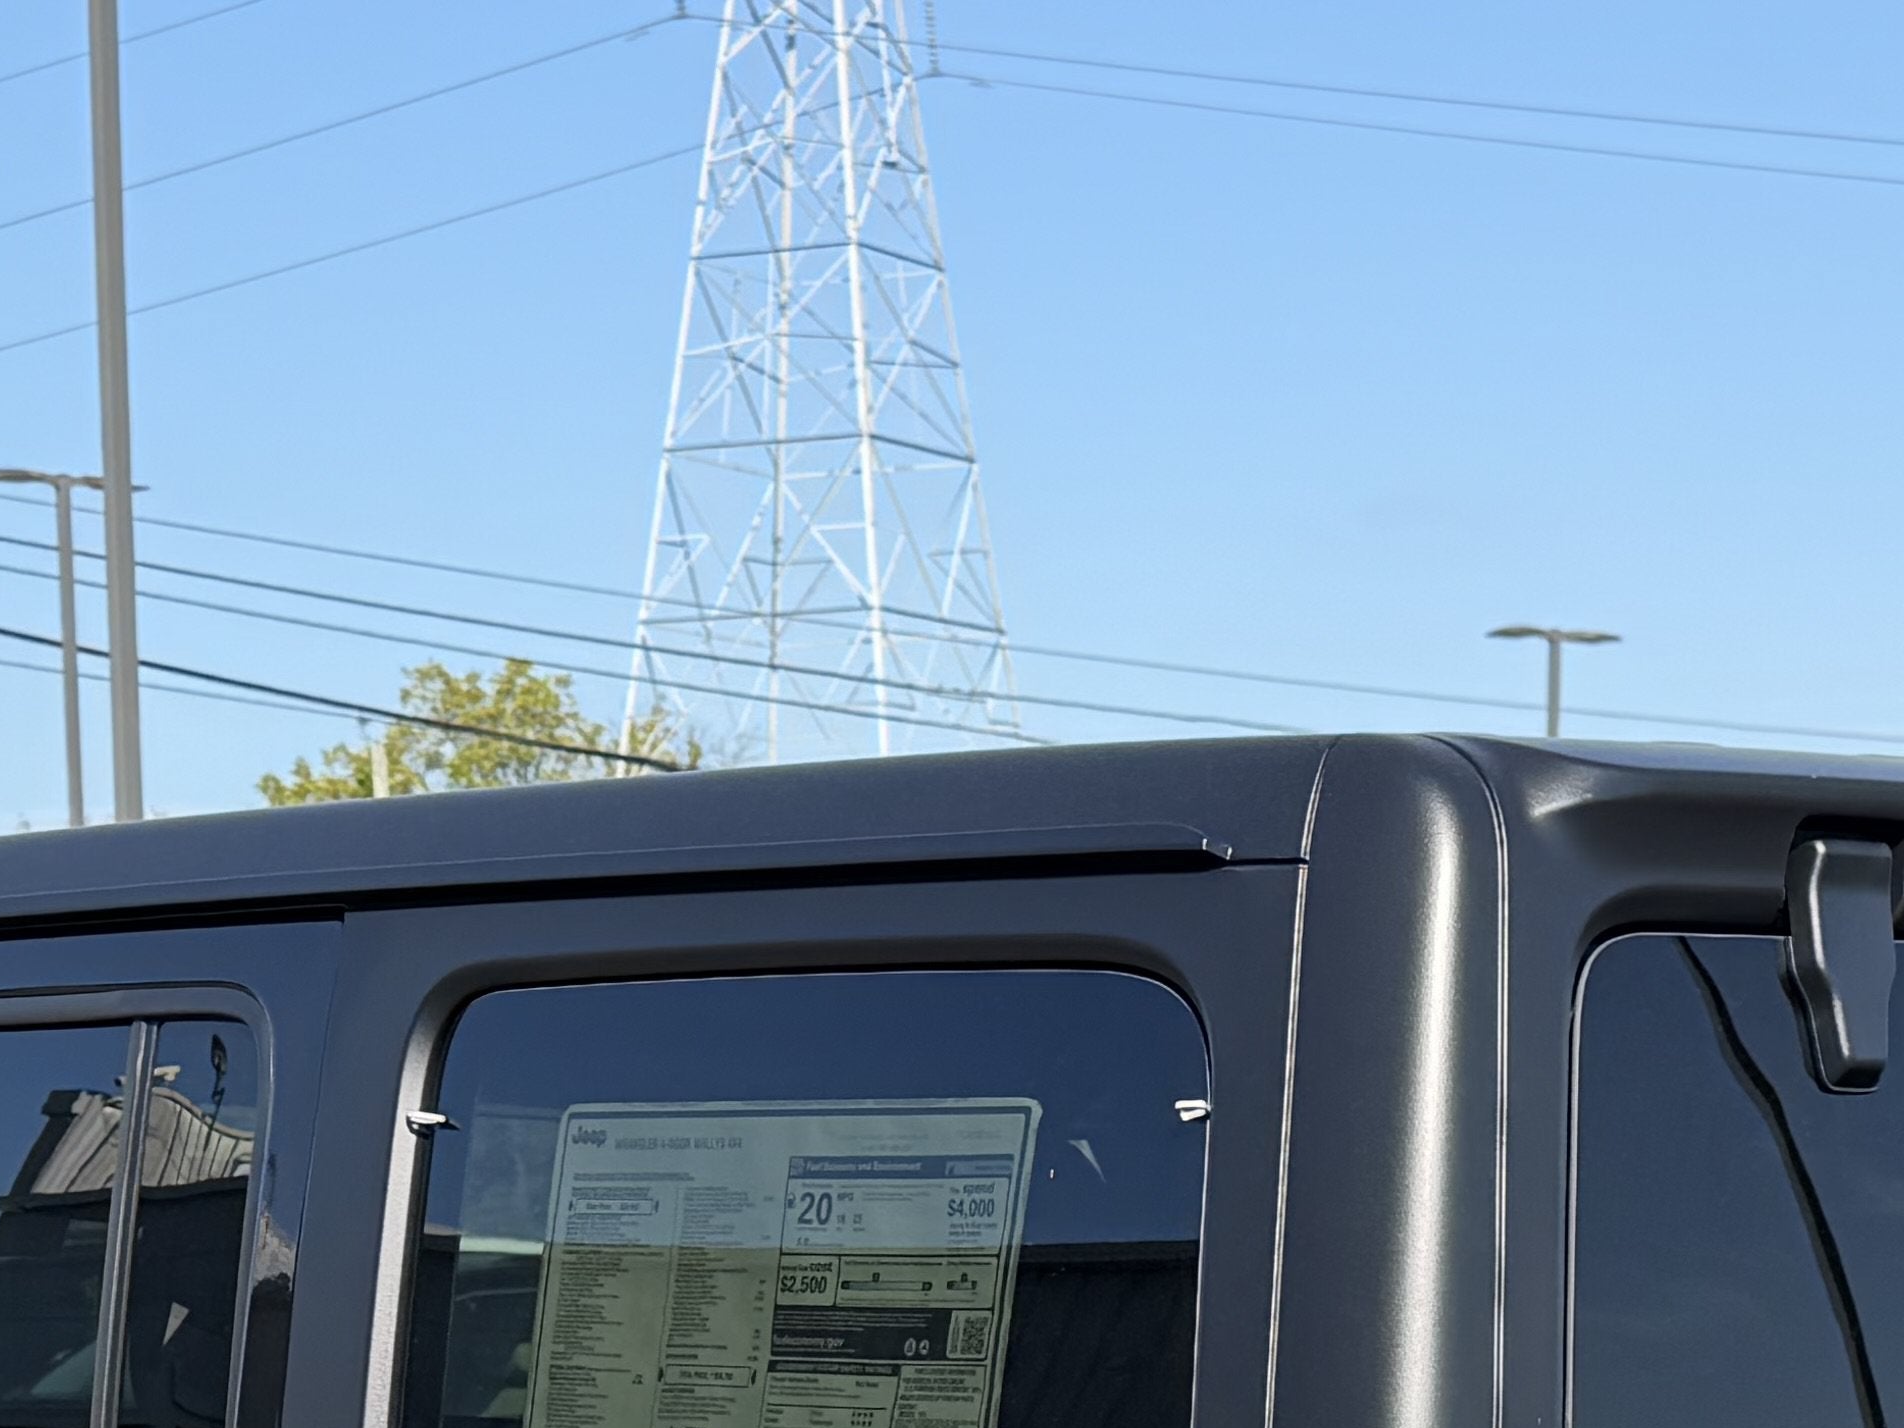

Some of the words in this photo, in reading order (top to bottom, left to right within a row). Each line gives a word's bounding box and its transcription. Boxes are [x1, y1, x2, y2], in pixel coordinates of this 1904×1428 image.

[571, 1125, 607, 1148] Jeep
[797, 1191, 833, 1225] 20
[947, 1198, 995, 1219] $4,000
[780, 1275, 827, 1294] $2,500
